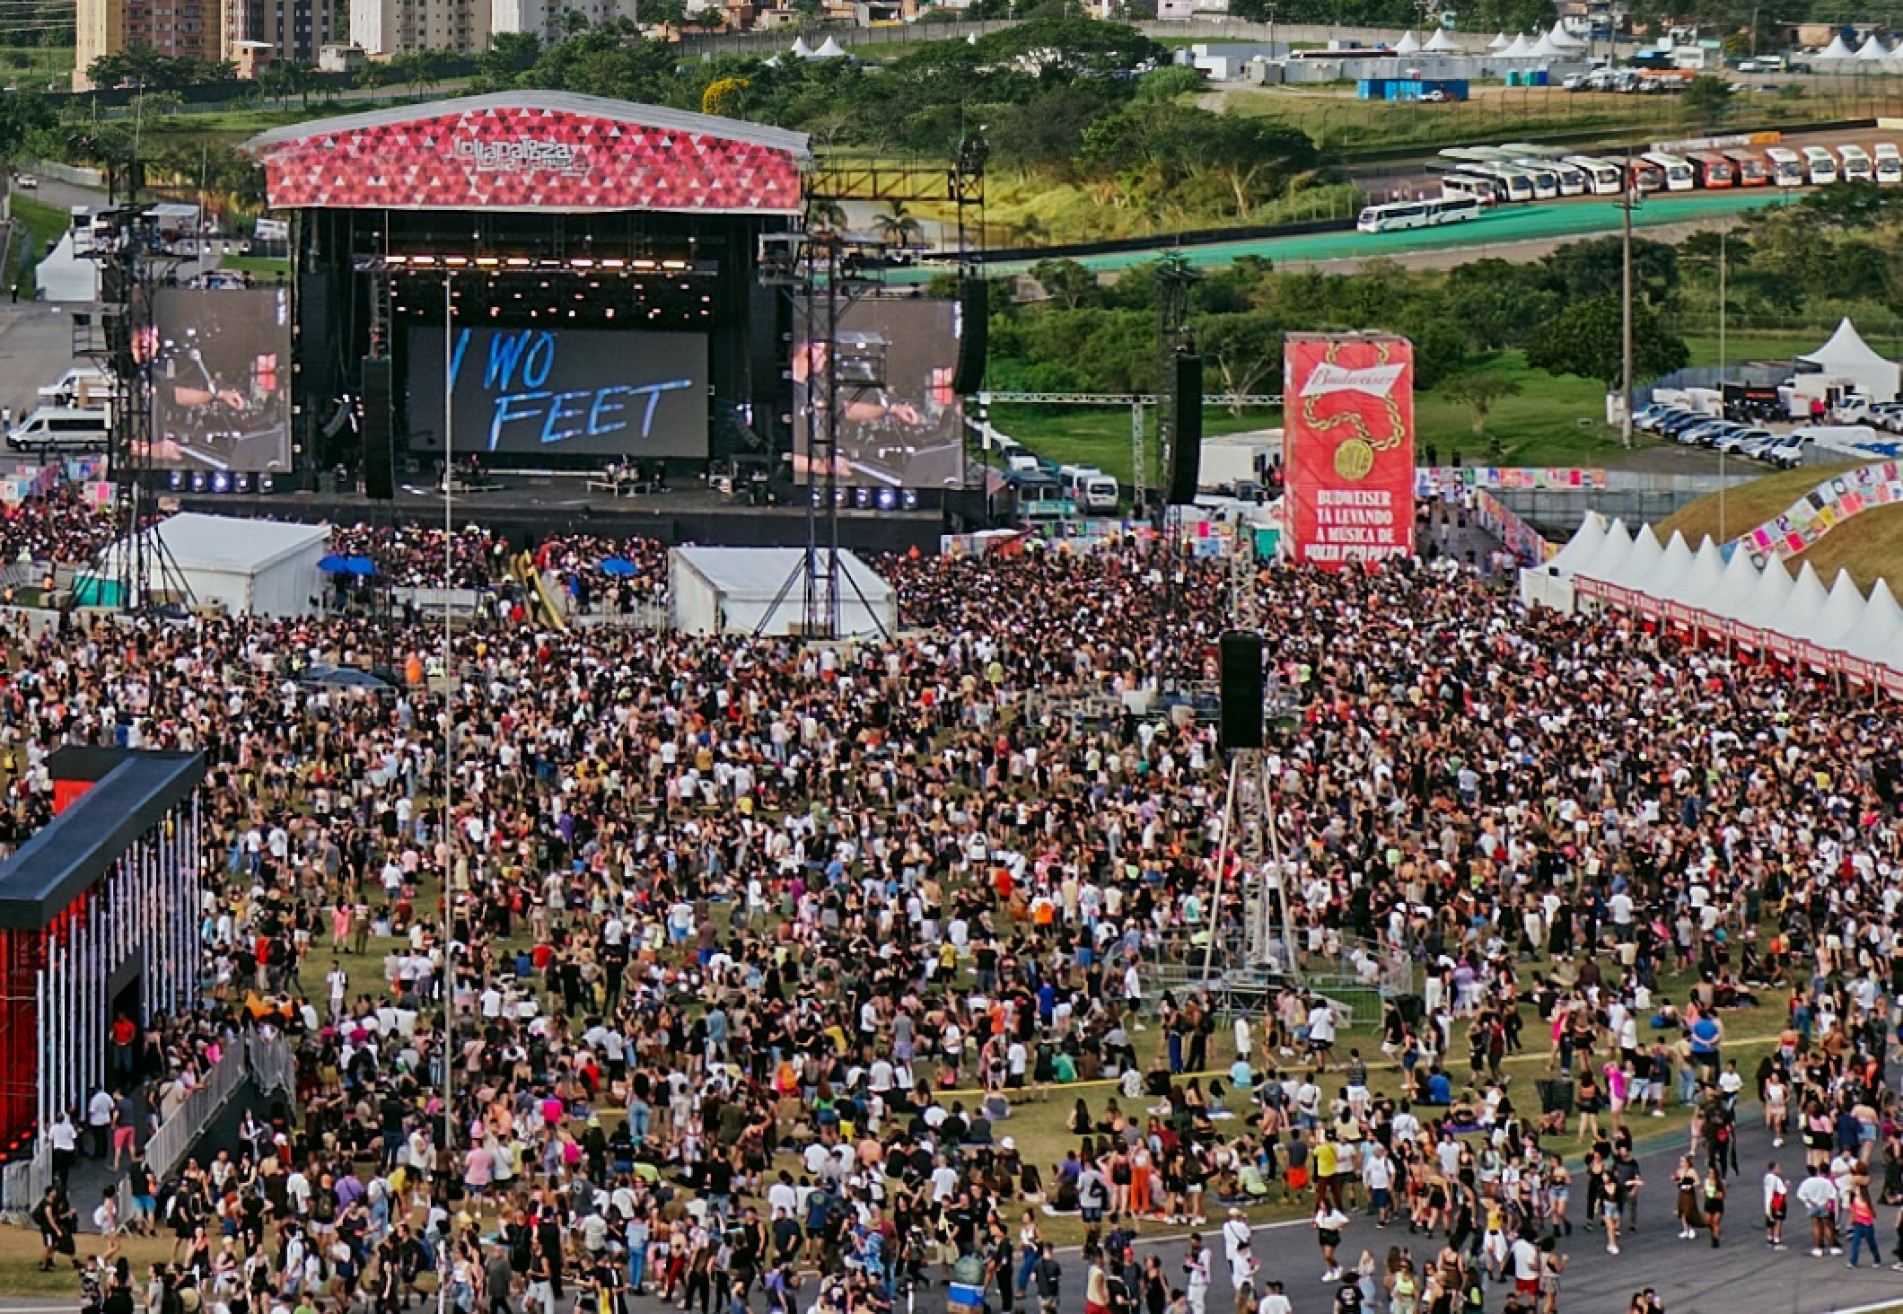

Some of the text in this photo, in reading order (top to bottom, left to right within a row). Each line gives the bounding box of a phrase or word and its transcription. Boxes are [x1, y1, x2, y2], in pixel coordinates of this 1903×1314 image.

[488, 379, 692, 452] FEET
[1317, 489, 1391, 506] BUDWEISER
[1335, 508, 1394, 524] LEVANDO
[1377, 528, 1395, 543] DE
